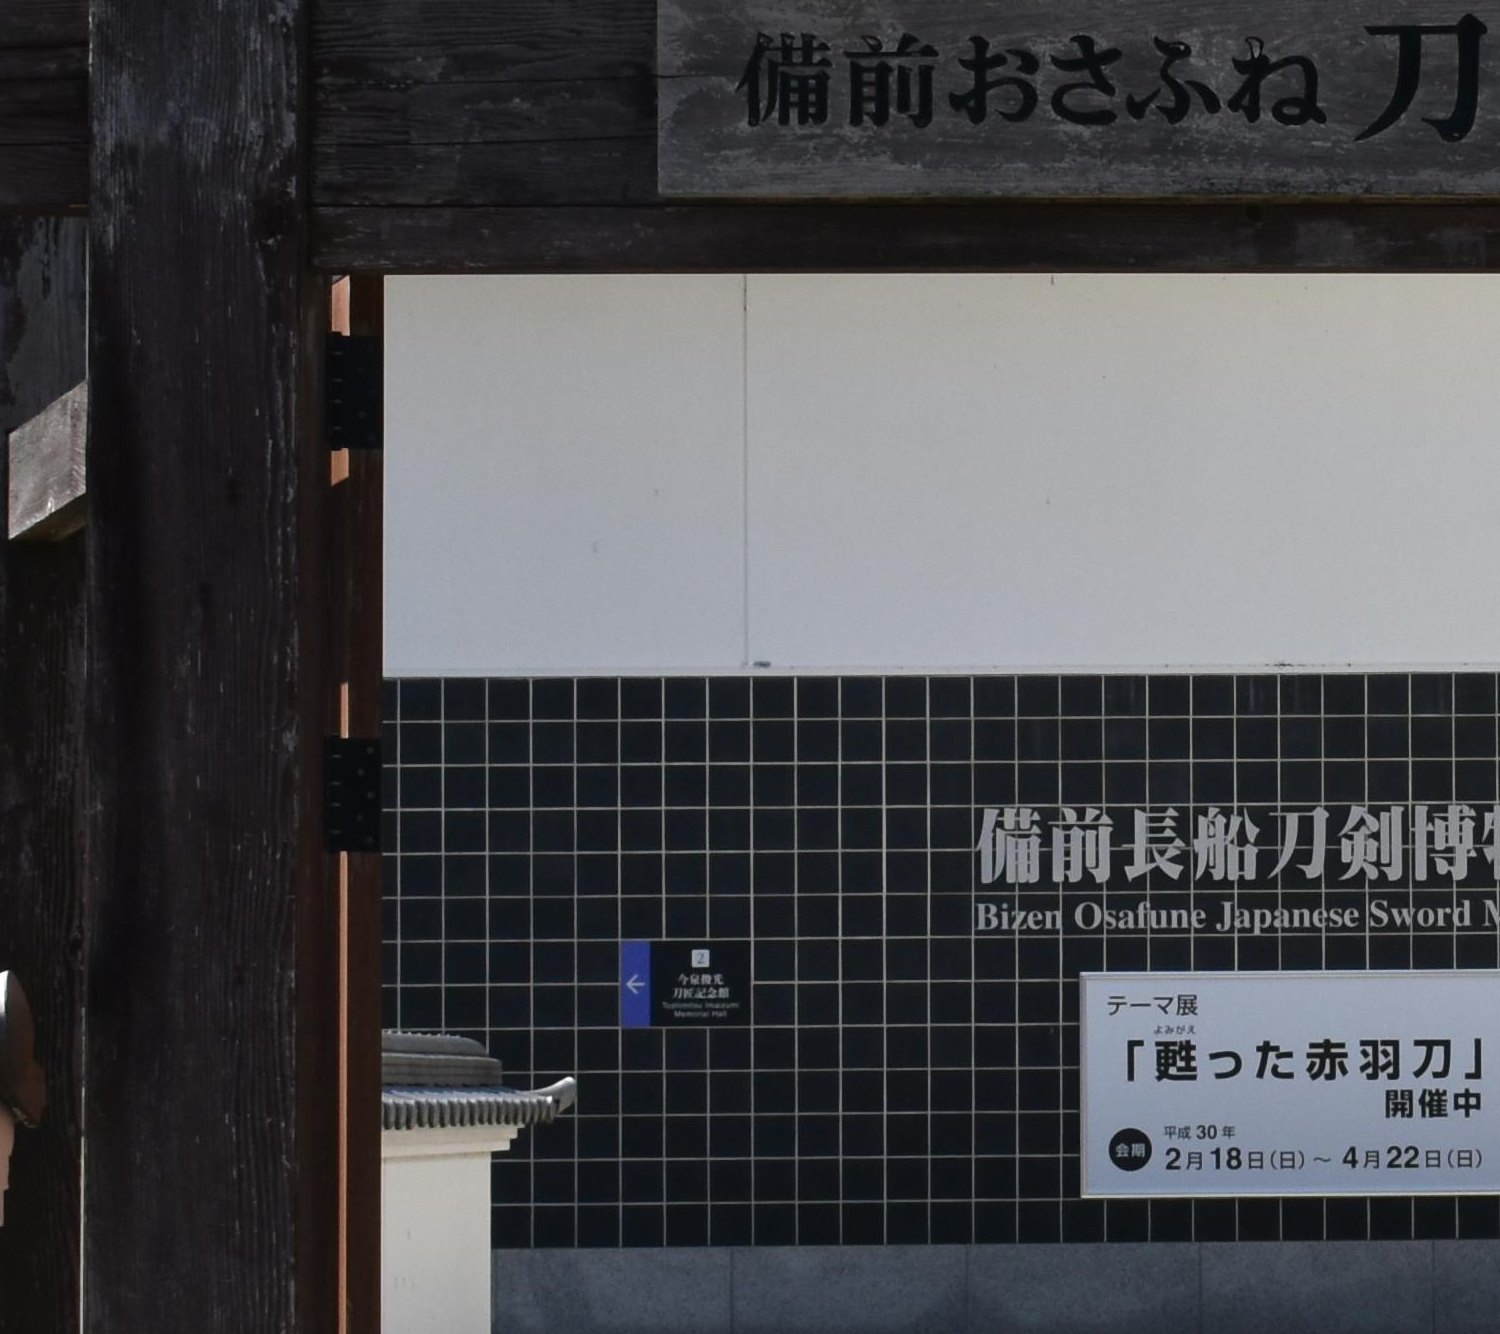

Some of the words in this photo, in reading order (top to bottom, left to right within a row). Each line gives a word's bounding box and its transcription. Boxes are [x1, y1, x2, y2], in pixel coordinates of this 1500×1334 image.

[975, 901, 1062, 932] Bizen
[1074, 900, 1207, 931] Osafune
[1215, 900, 1360, 935] Japanese
[1369, 899, 1471, 929] Sword
[1107, 994, 1199, 1016] テーマ展
[1153, 1024, 1197, 1036] よみがえ
[1384, 1088, 1483, 1119] 開催中
[1114, 1143, 1146, 1159] 会期
